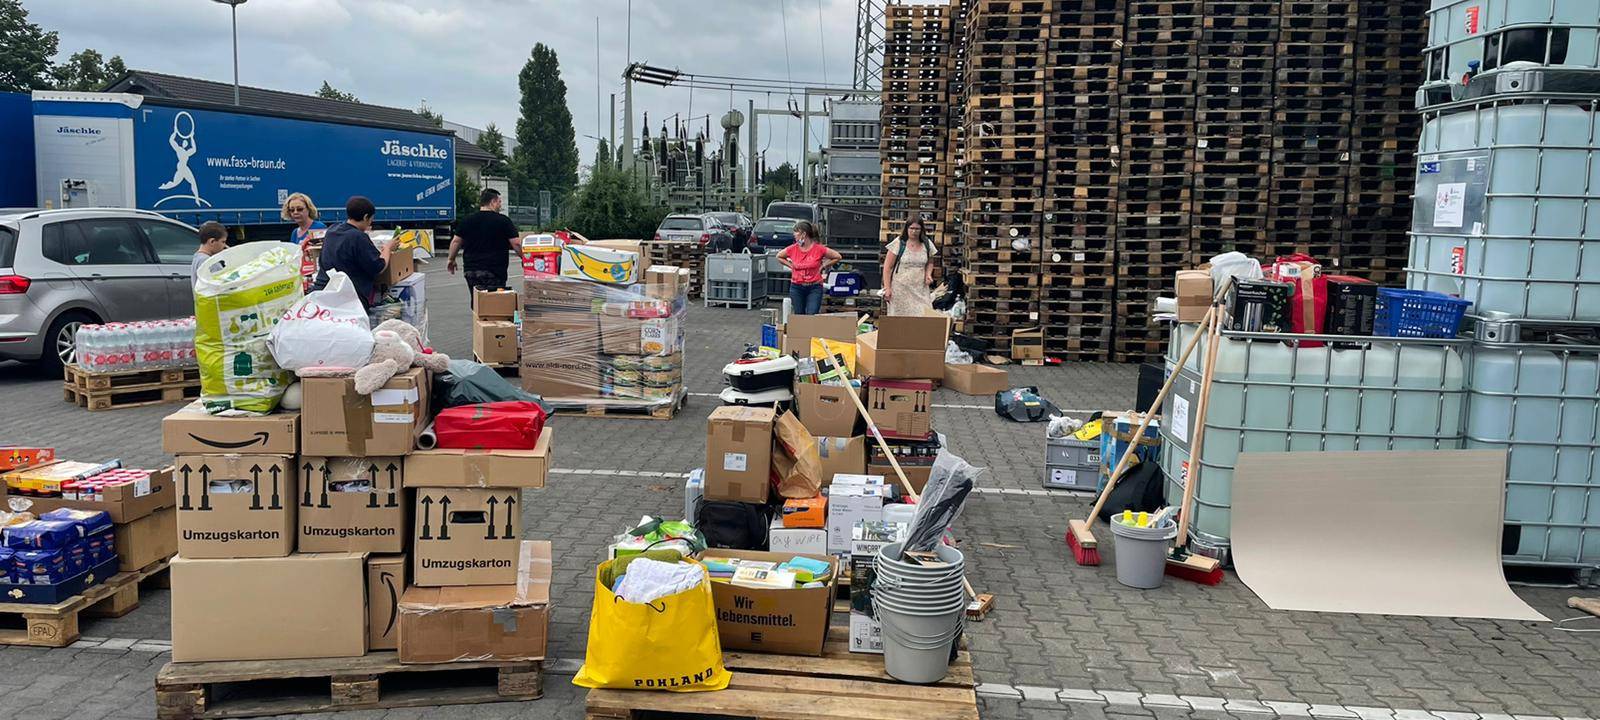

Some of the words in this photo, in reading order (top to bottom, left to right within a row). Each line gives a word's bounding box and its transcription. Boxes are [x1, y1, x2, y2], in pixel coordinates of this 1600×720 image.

[57, 126, 101, 135] Jäschke
[381, 140, 447, 159] Jäschke
[207, 155, 286, 169] www.fass-braun.de
[183, 529, 280, 543] Umzugskarton
[303, 525, 396, 538] Umzugskarton
[421, 558, 512, 571] Umzugskarton
[734, 595, 754, 610] Wir
[717, 608, 796, 627] Lebensmittel.
[33, 626, 53, 637] EPAL
[634, 667, 713, 687] POHLAND
